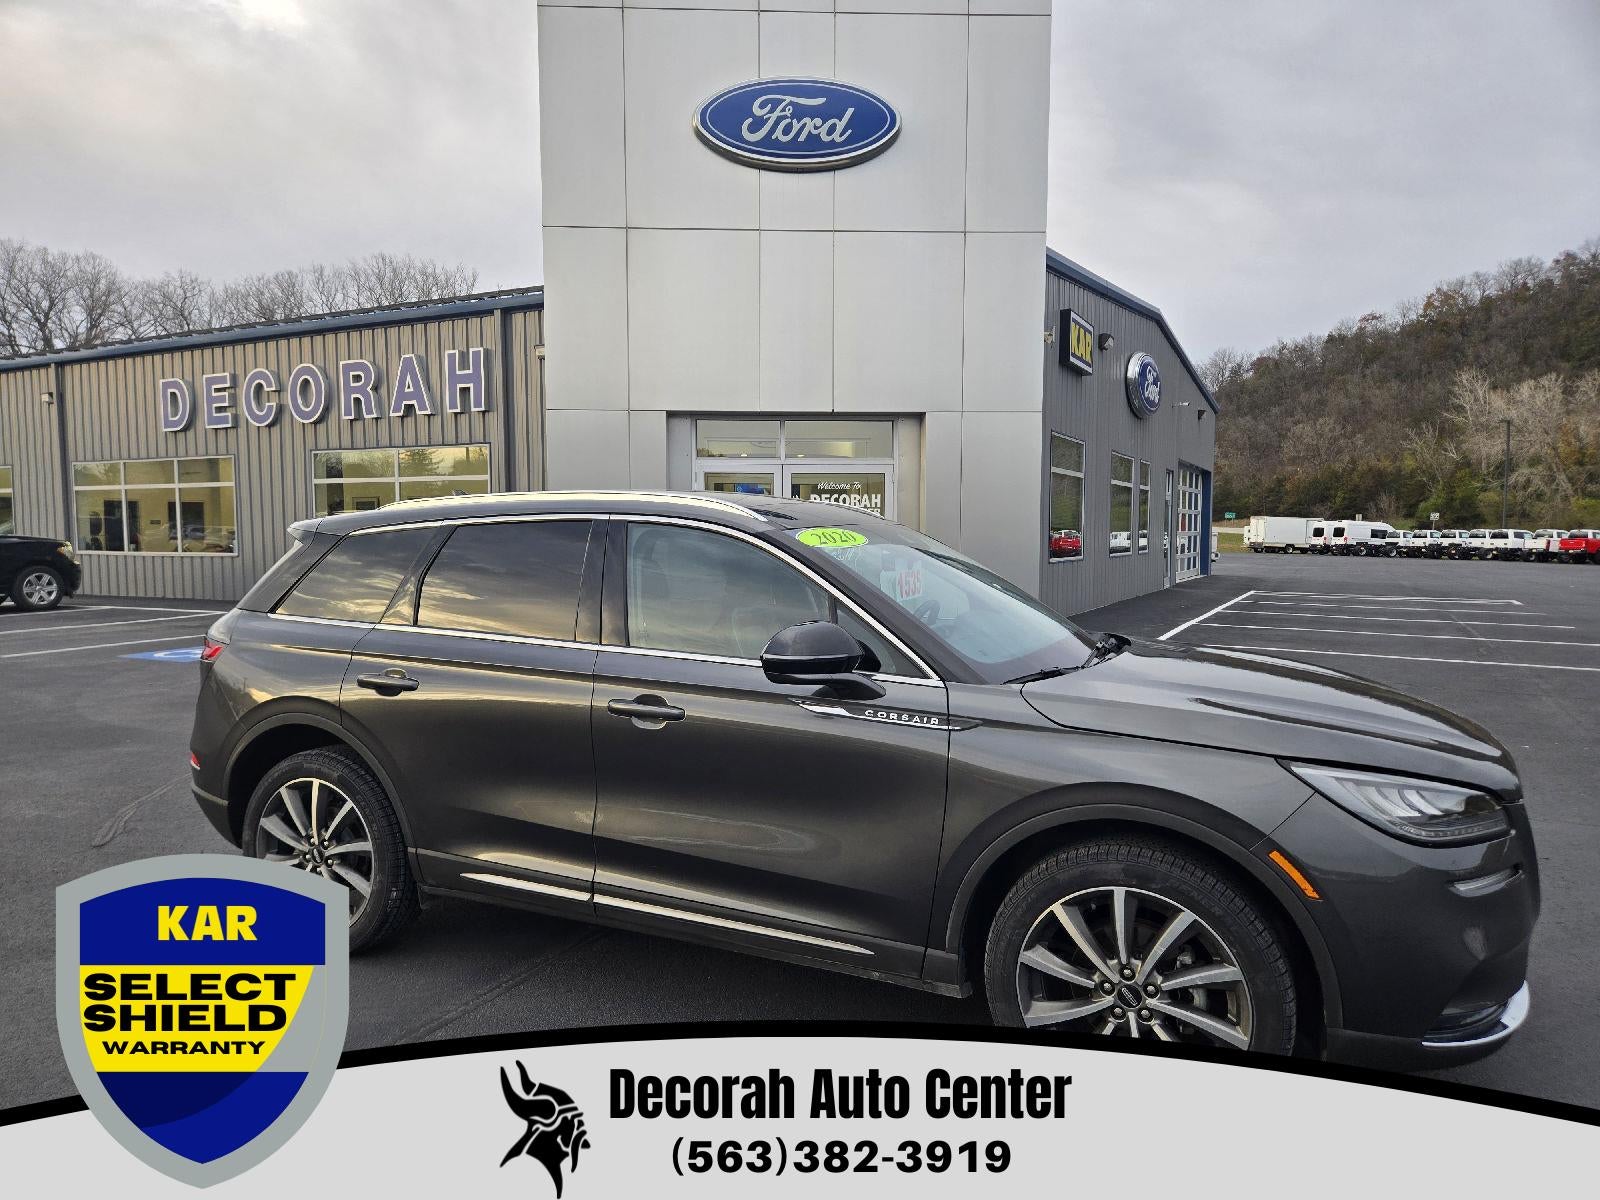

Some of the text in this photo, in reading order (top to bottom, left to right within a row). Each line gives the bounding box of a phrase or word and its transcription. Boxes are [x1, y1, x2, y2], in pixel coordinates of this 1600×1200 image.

[741, 95, 855, 143] Ford
[1071, 322, 1093, 364] KAR
[160, 348, 485, 432] DECORAH
[1144, 366, 1161, 404] Ford
[817, 481, 862, 490] Welcome To
[811, 531, 857, 544] 2020
[864, 709, 939, 725] CORSAIR
